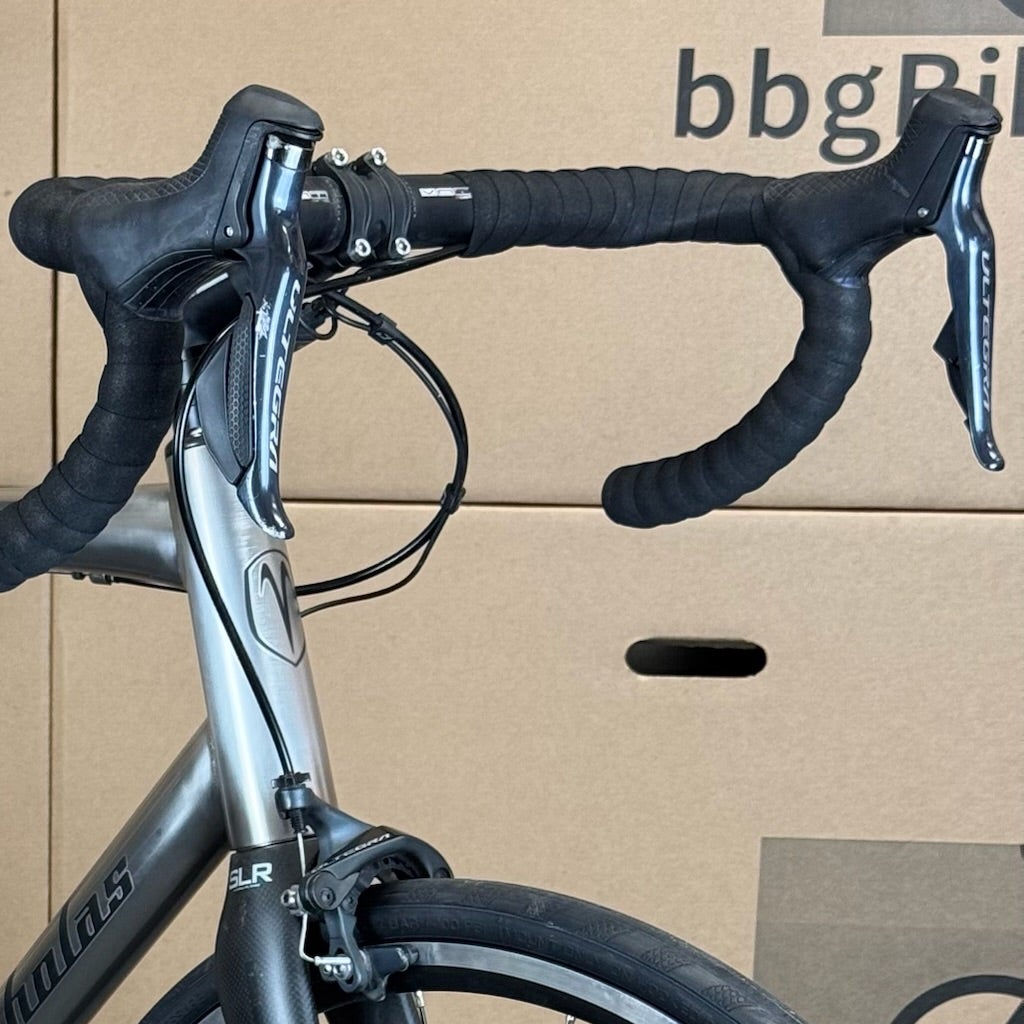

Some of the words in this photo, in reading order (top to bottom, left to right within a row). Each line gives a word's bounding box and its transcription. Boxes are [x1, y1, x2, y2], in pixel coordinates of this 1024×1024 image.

[675, 47, 1024, 164] bbgBi
[269, 279, 301, 474] ULTEGRA
[981, 250, 992, 412] ULTEGRA
[229, 862, 273, 890] SLR
